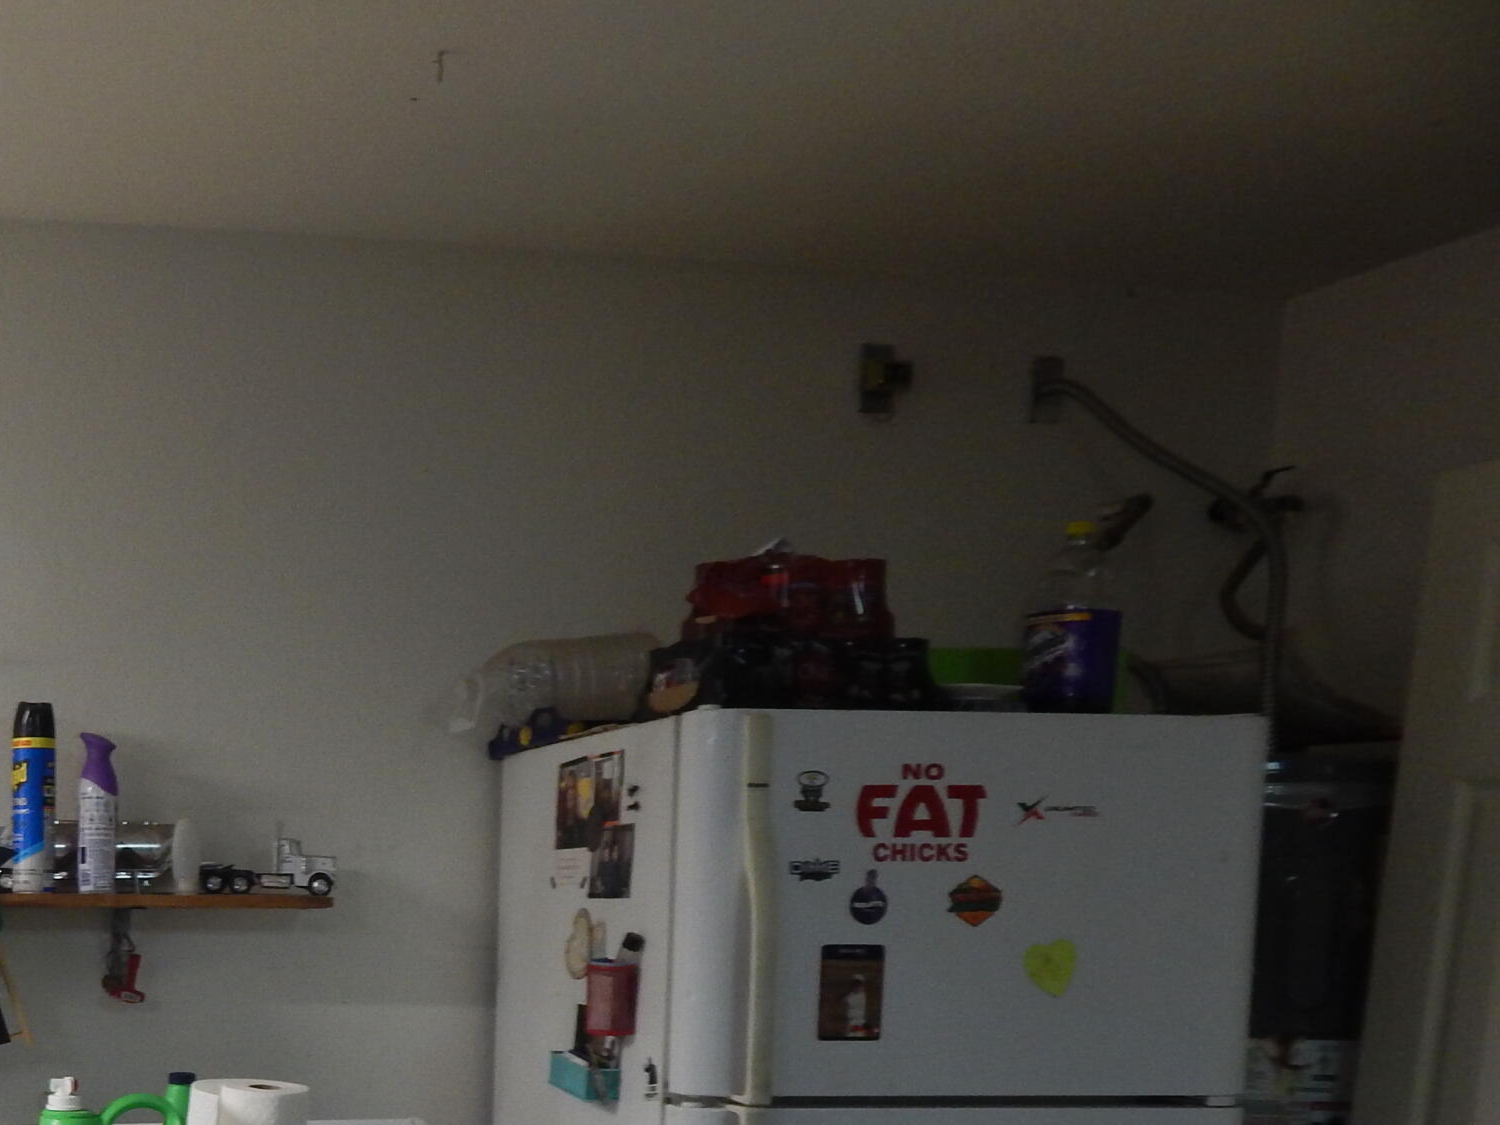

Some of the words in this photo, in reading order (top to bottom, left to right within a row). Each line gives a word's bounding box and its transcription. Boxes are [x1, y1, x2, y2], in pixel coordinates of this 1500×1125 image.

[901, 763, 945, 781] NO
[856, 784, 988, 839] FAT
[872, 842, 969, 863] CHICKS
